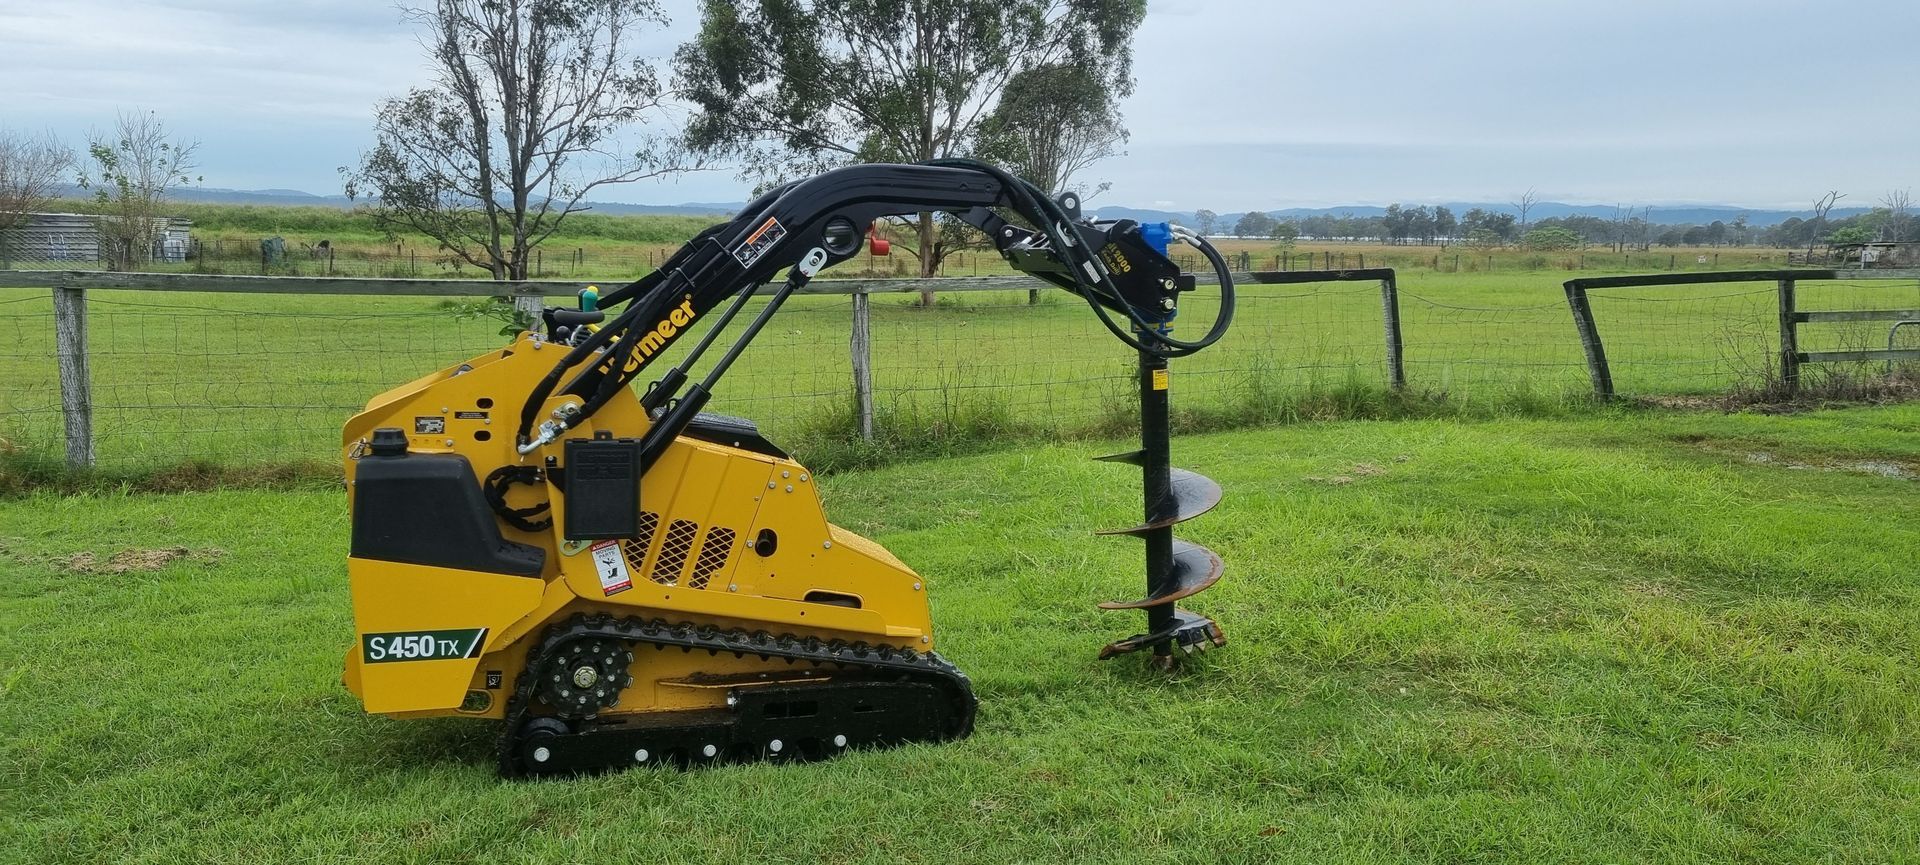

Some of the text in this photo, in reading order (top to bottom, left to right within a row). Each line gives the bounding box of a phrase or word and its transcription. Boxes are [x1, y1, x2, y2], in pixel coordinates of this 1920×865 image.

[1113, 250, 1131, 272] 2000
[595, 540, 617, 550] DANGER
[595, 546, 616, 555] MOVING
[598, 550, 616, 559] PARTS
